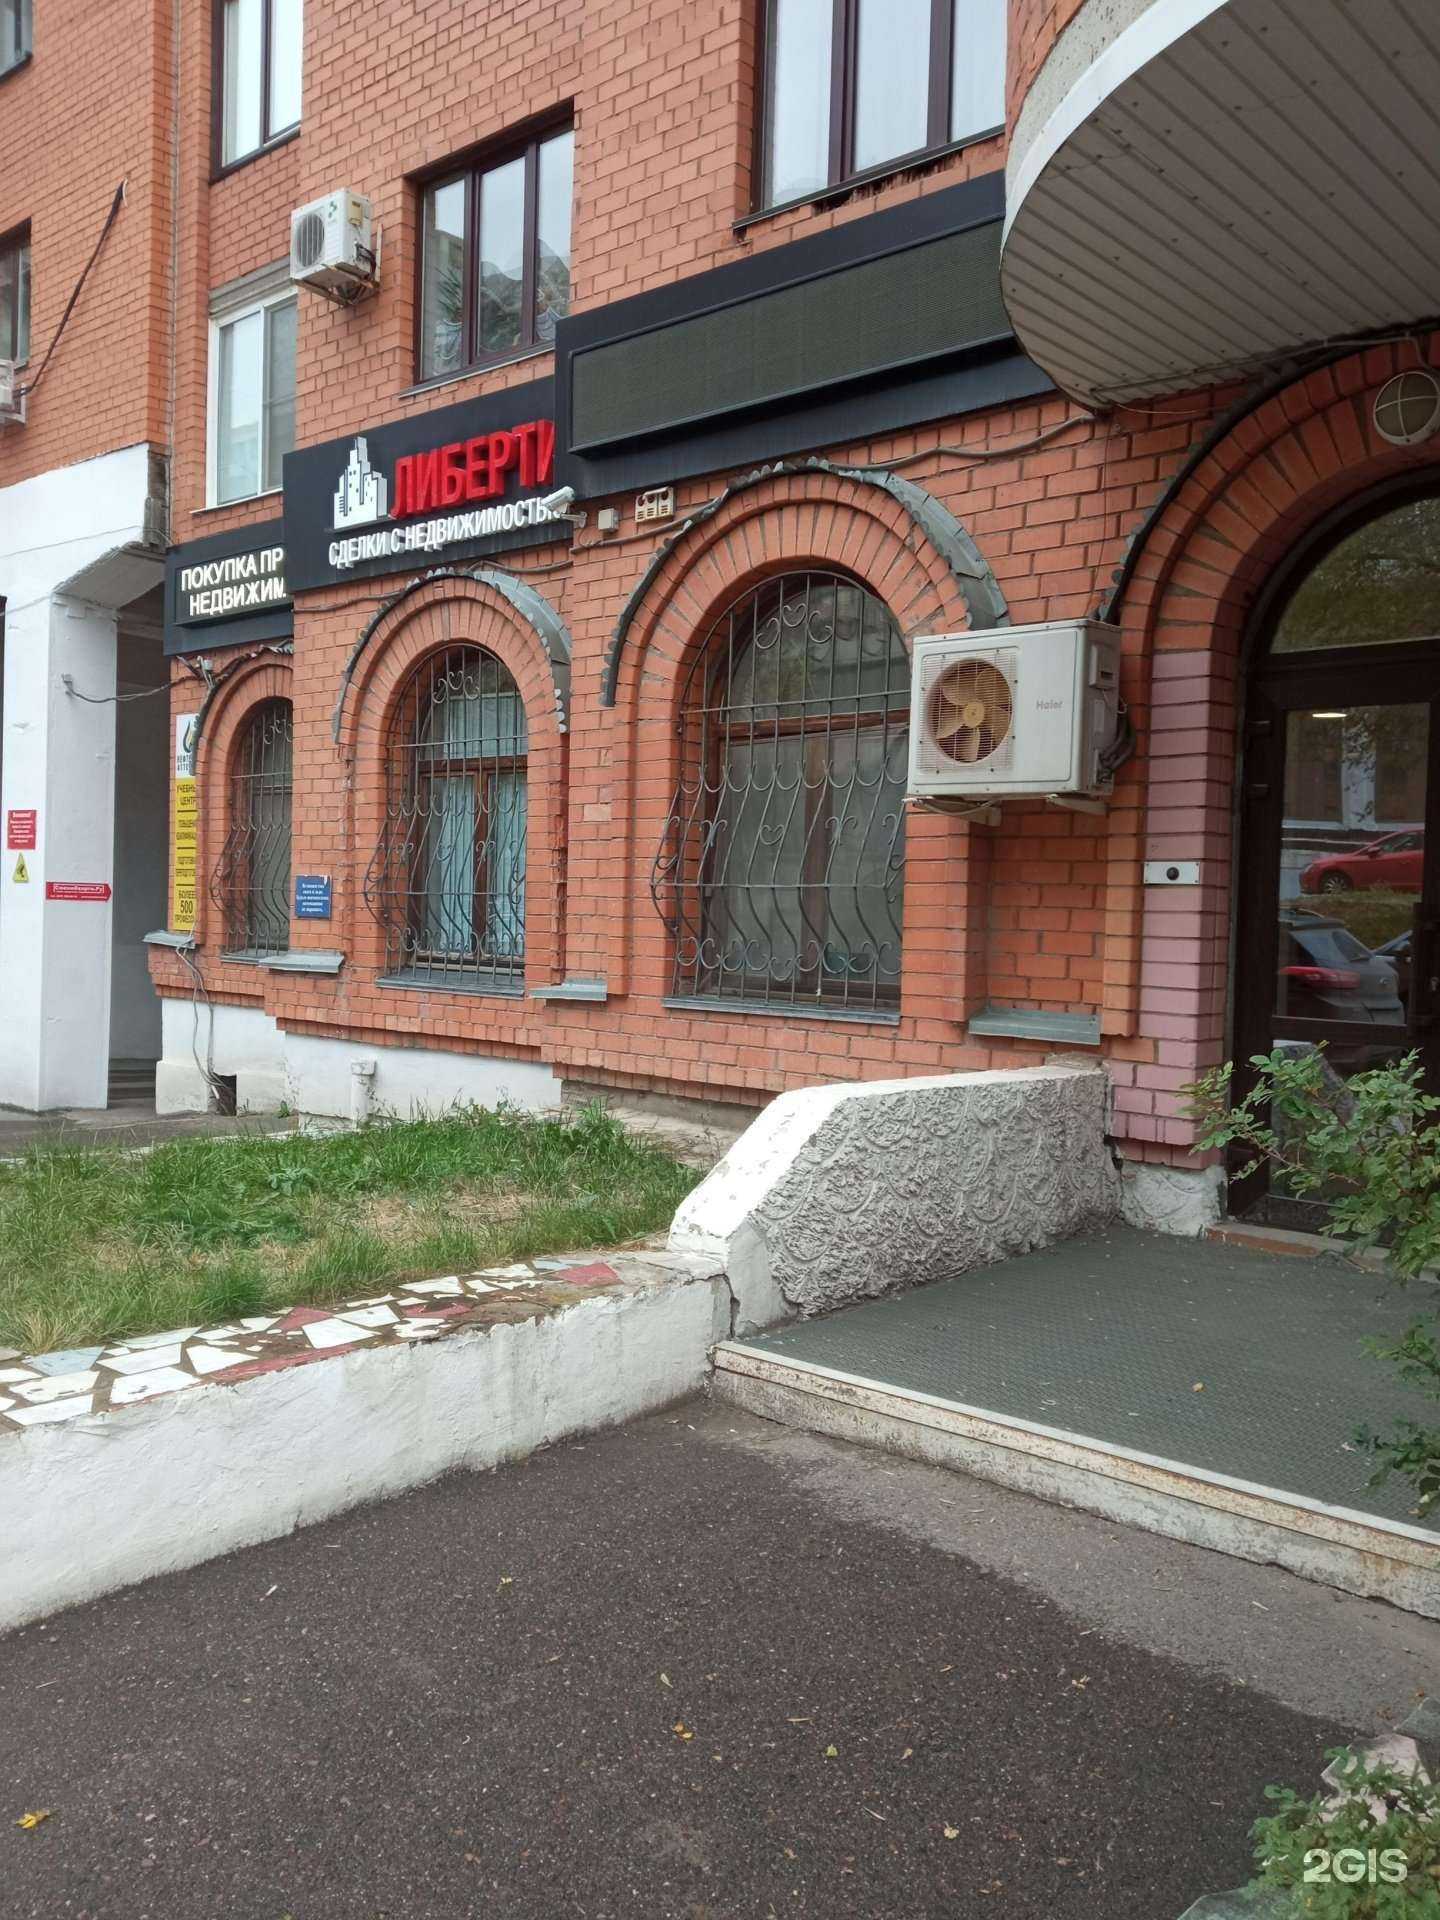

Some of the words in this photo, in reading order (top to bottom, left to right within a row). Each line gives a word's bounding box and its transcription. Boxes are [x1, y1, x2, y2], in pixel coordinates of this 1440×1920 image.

[328, 531, 391, 569] СДЕЛКИ
[391, 527, 405, 553] С
[181, 553, 258, 592] ПОКУПКА
[260, 547, 285, 574] ПР
[189, 577, 287, 617] НЕДВИЖИМ.
[1035, 699, 1063, 711] Haier
[180, 900, 193, 914] 500
